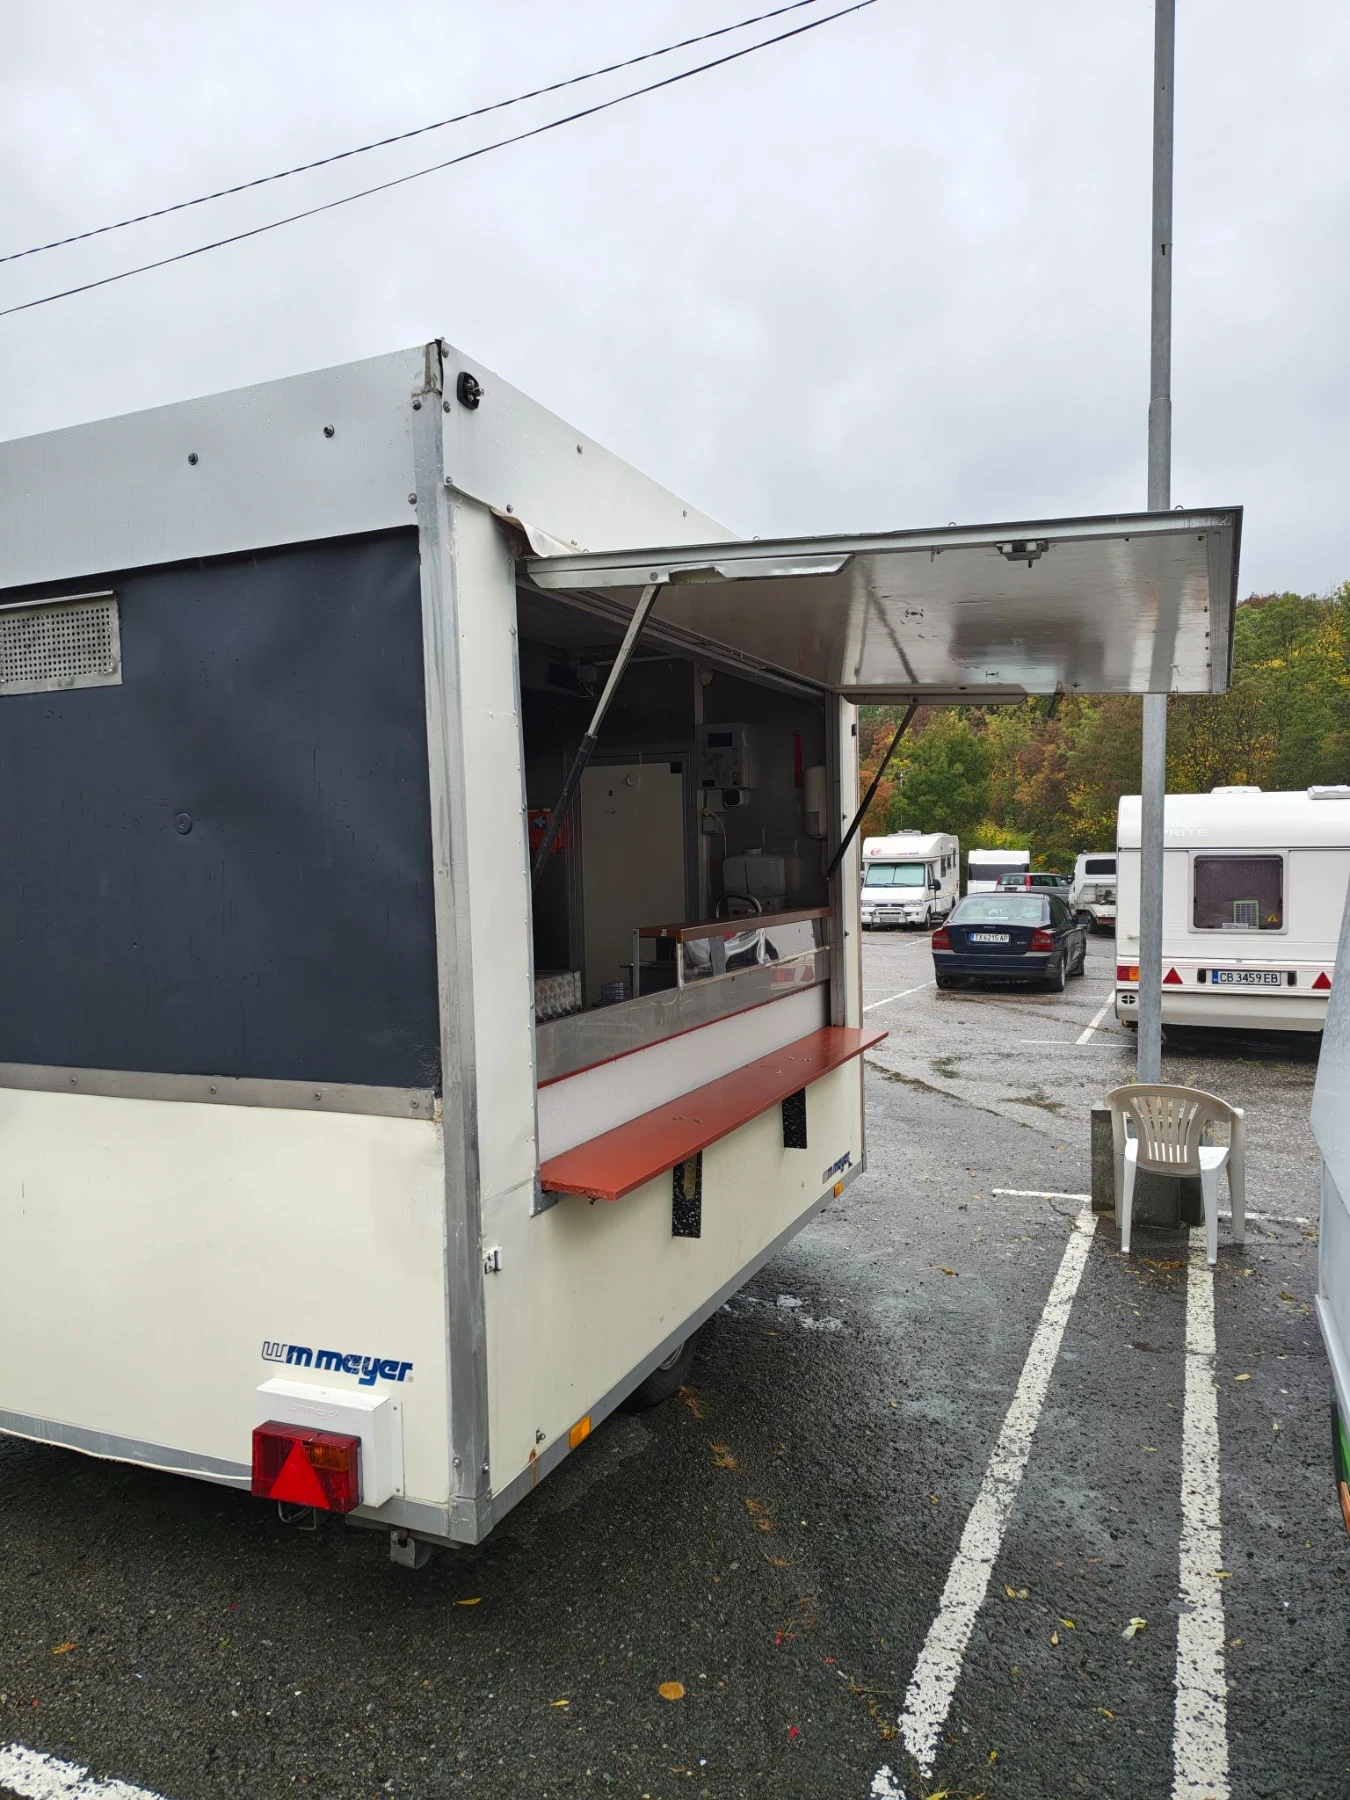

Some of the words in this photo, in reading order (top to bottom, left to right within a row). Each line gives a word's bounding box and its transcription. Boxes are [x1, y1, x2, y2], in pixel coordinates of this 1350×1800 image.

[983, 934, 999, 942] 6215
[1219, 972, 1234, 983] CB
[1235, 972, 1262, 984] 3459
[1263, 973, 1278, 984] EB
[314, 1349, 414, 1387] meyer
